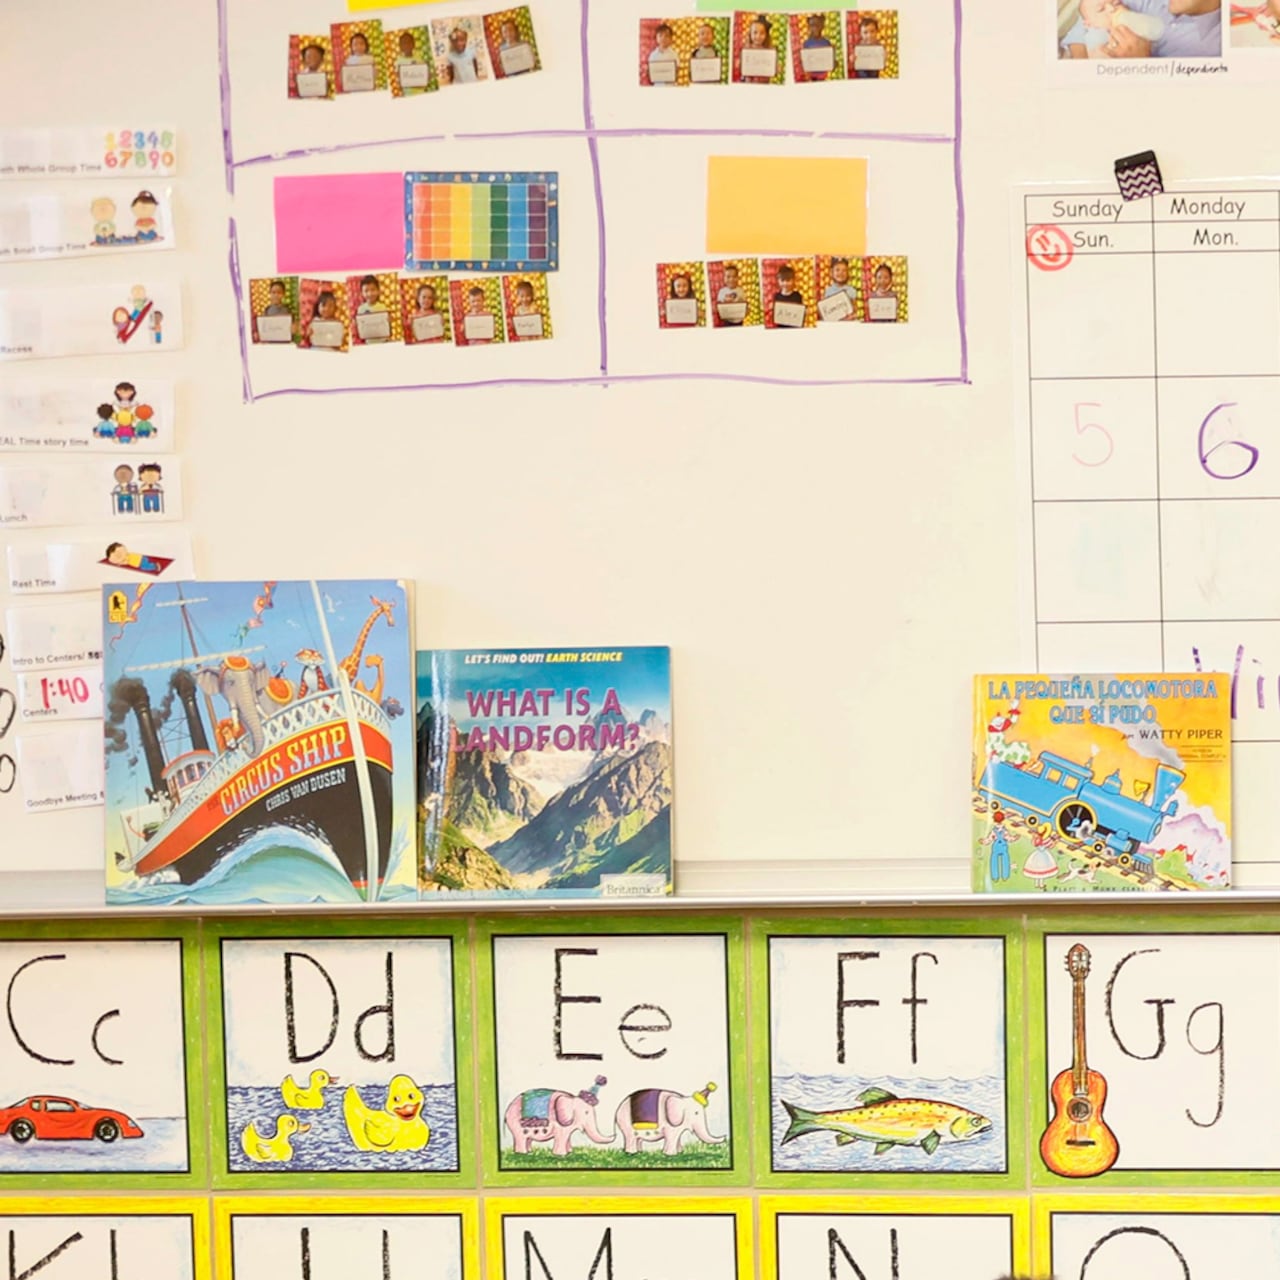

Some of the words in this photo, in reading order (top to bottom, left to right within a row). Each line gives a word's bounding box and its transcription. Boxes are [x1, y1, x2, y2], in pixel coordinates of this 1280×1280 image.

[80, 163, 102, 172] Time
[1052, 201, 1124, 223] Sunday
[1171, 197, 1247, 220] Monday
[67, 242, 87, 250] Time
[1073, 230, 1115, 249] Sun.
[1194, 228, 1239, 247] Mon.
[19, 437, 41, 445] Time
[44, 438, 67, 447] story
[69, 438, 89, 446] time
[1072, 402, 1114, 467] 5
[1198, 402, 1260, 480] 6
[12, 579, 33, 588] Rest
[35, 579, 57, 587] Time
[13, 657, 34, 666] Intro
[35, 656, 45, 664] to
[464, 654, 491, 664] LET'S
[493, 653, 518, 664] FIND
[520, 653, 544, 663] OUT!
[545, 653, 578, 663] EARTH
[580, 651, 623, 662] SCIENCE
[41, 677, 90, 709] 1:40
[988, 681, 1010, 700] LA
[1014, 675, 1095, 700] PEQUEÑA
[1098, 679, 1218, 699] LOCOMOTORA
[23, 707, 59, 717] Centers
[465, 688, 554, 717] WHAT
[566, 688, 591, 716] IS
[602, 687, 622, 716] A
[1049, 704, 1085, 725] QUE
[1109, 704, 1157, 725] PUDO
[1139, 729, 1183, 740] WATTY
[1187, 729, 1223, 739] PIPER
[220, 751, 284, 816] CIRCUS
[287, 725, 347, 775] SHIP
[27, 796, 64, 808] Goodbye
[66, 792, 98, 803] Meeting
[265, 788, 291, 811] CHRIS
[290, 783, 310, 800] VAN
[310, 767, 347, 793] DUSEN
[606, 883, 662, 896] Britannica
[6, 953, 125, 1065] Cc
[284, 951, 396, 1064] Dd
[553, 947, 673, 1060] Ee
[836, 951, 939, 1065] Ff
[1104, 948, 1224, 1128] Gg
